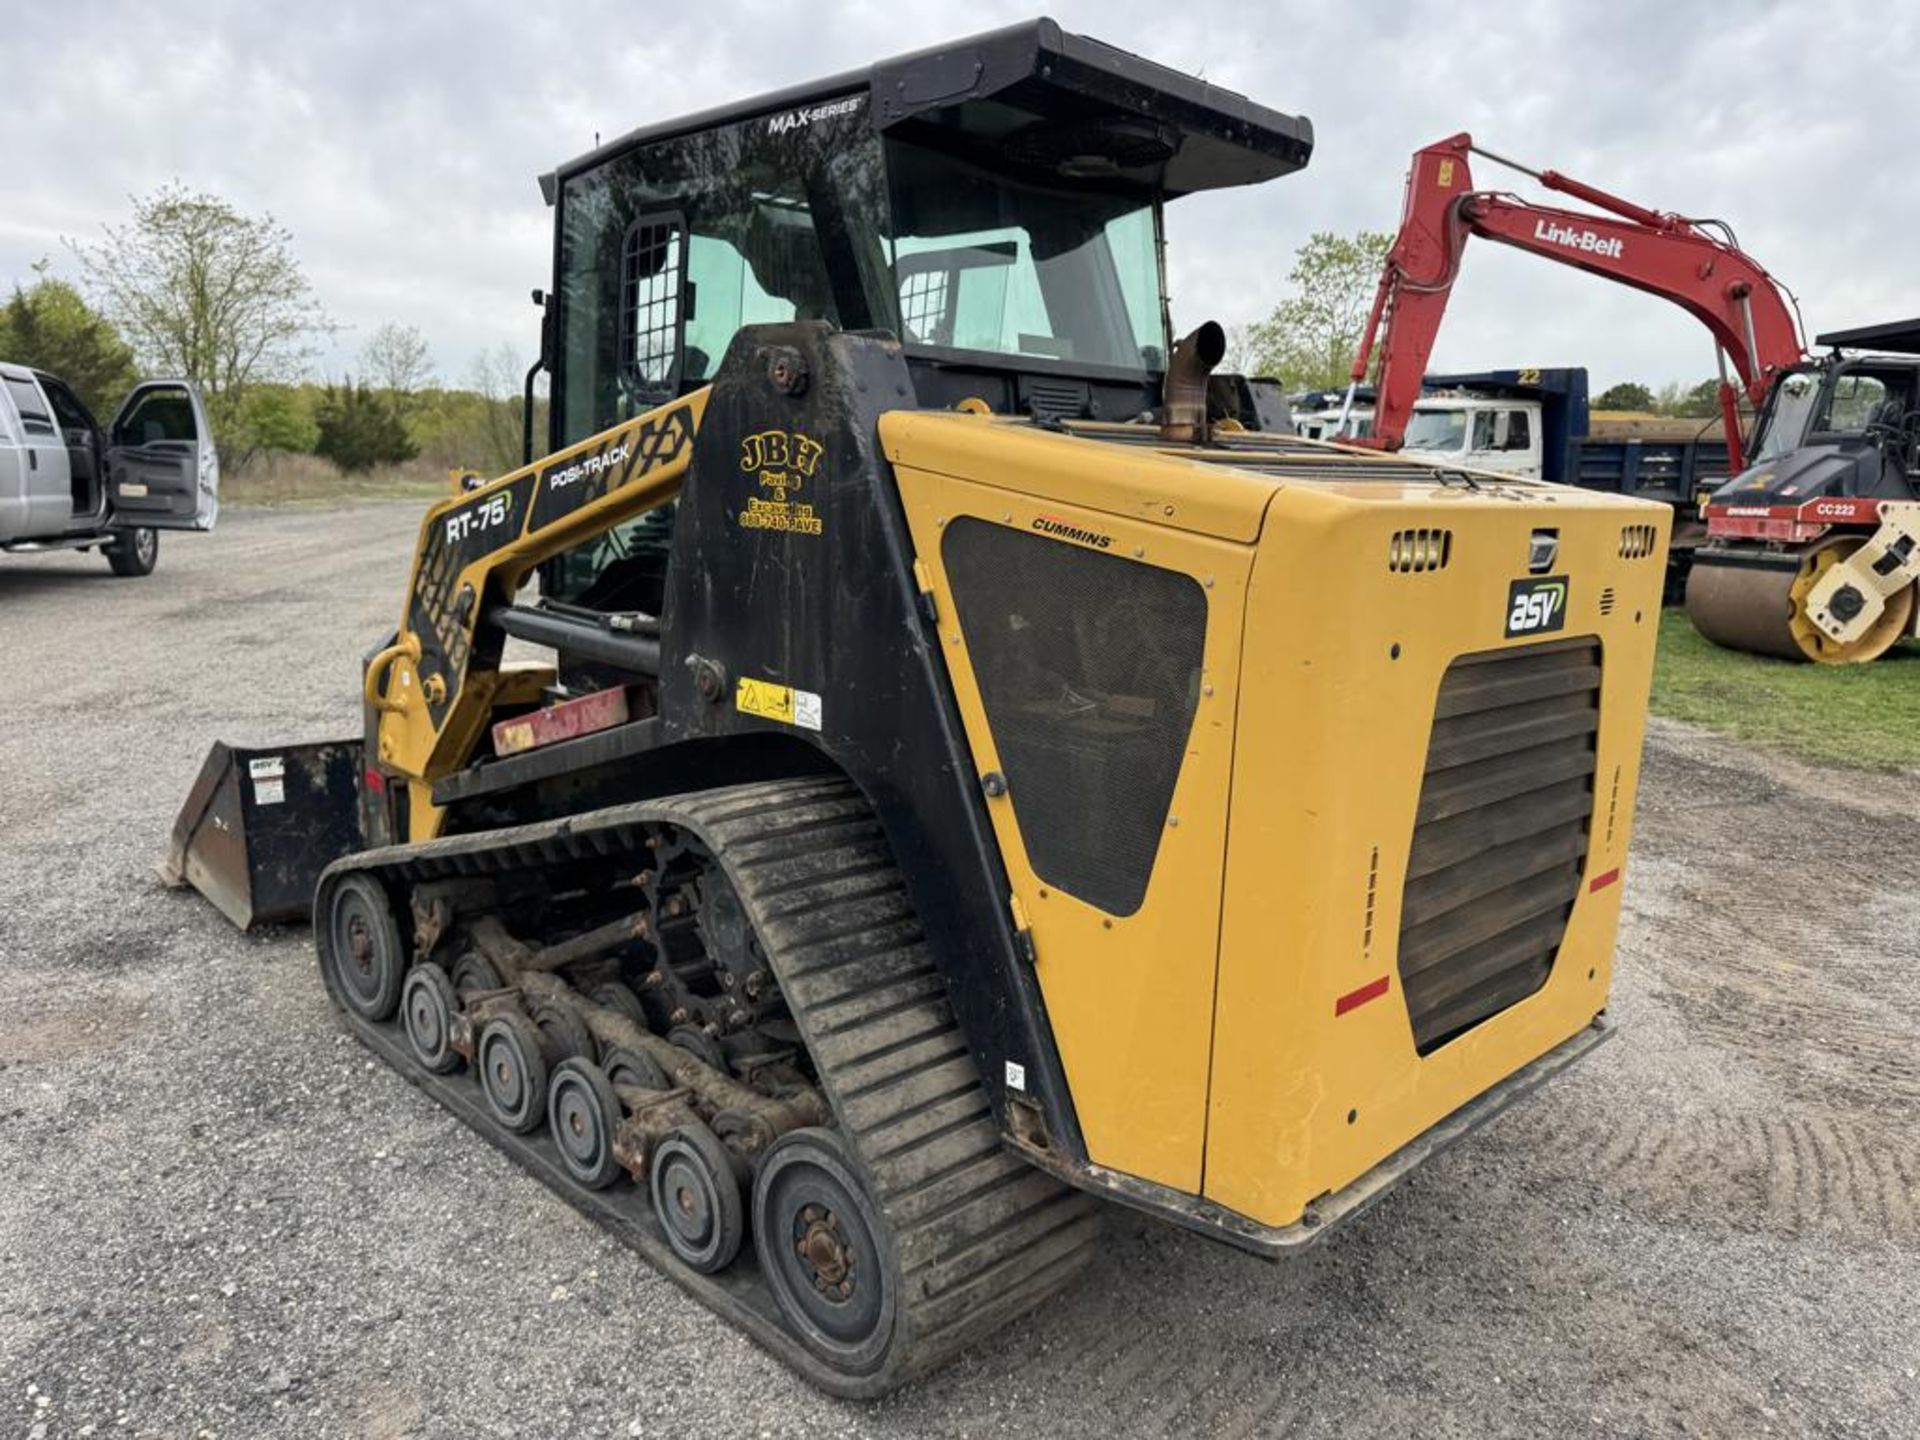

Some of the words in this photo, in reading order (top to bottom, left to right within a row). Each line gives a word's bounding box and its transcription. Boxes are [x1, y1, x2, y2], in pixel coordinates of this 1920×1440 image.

[1534, 219, 1623, 259] Link-Belt
[1517, 369, 1540, 384] 22
[550, 443, 629, 490] POSI-TRACK
[446, 498, 505, 544] RT-75
[1032, 518, 1111, 548] CUMMINS
